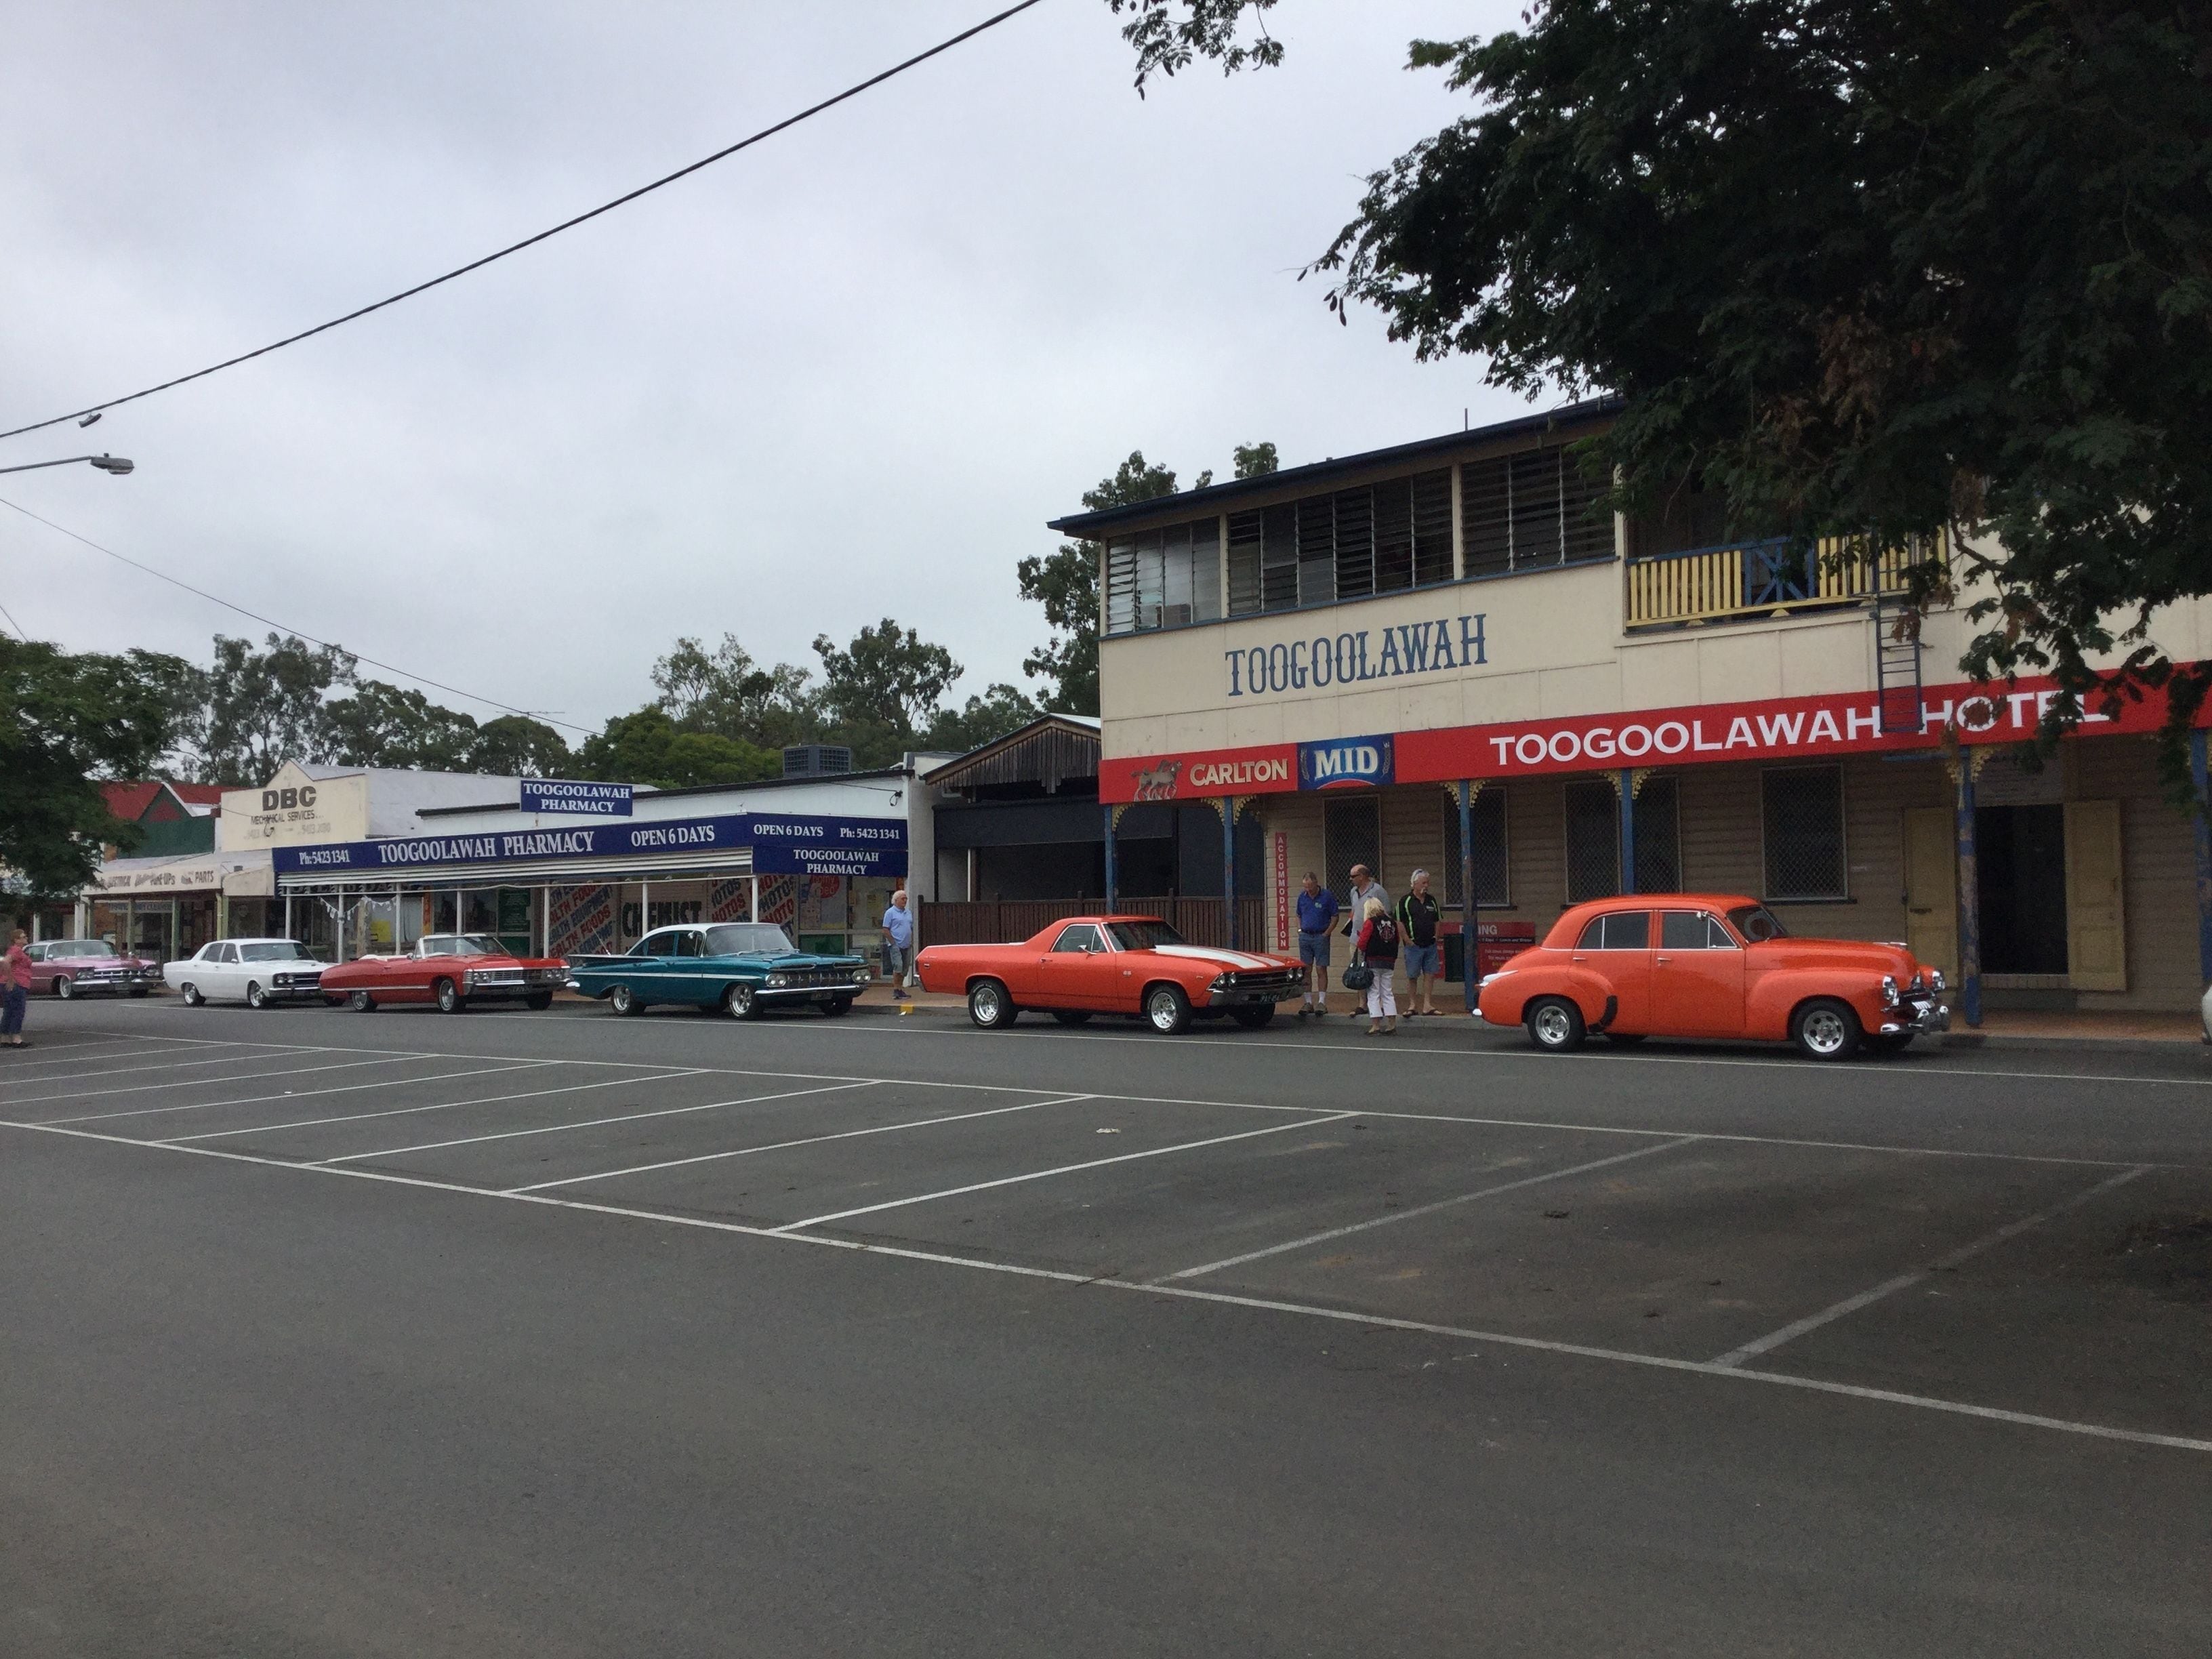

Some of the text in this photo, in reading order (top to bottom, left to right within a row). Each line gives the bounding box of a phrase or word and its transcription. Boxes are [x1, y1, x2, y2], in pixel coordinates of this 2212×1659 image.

[1225, 613, 1488, 697] TOOGOOLAWAH
[1490, 706, 1882, 765] TOOGOOLAWAH
[1190, 758, 1288, 786] CARLTON
[1315, 745, 1378, 780] MID
[262, 785, 316, 811] DBC
[524, 783, 630, 799] TOOGOOLAWAH
[541, 798, 615, 812] PHARMACY
[631, 825, 715, 846] OPEN 6 DAYS
[754, 824, 900, 839] OPEN 6 DAYS Ph: 5423 1341
[333, 849, 350, 863] 1341
[378, 831, 594, 863] TOOGOOLAWAH PHARMACY
[794, 849, 879, 862] TOOGOOLAWAH
[195, 870, 213, 882] PARTS
[807, 863, 867, 875] PHARMACY
[1277, 836, 1286, 947] ACCOMMODATION
[580, 904, 611, 939] FOODS
[623, 901, 701, 937] CHEMIST
